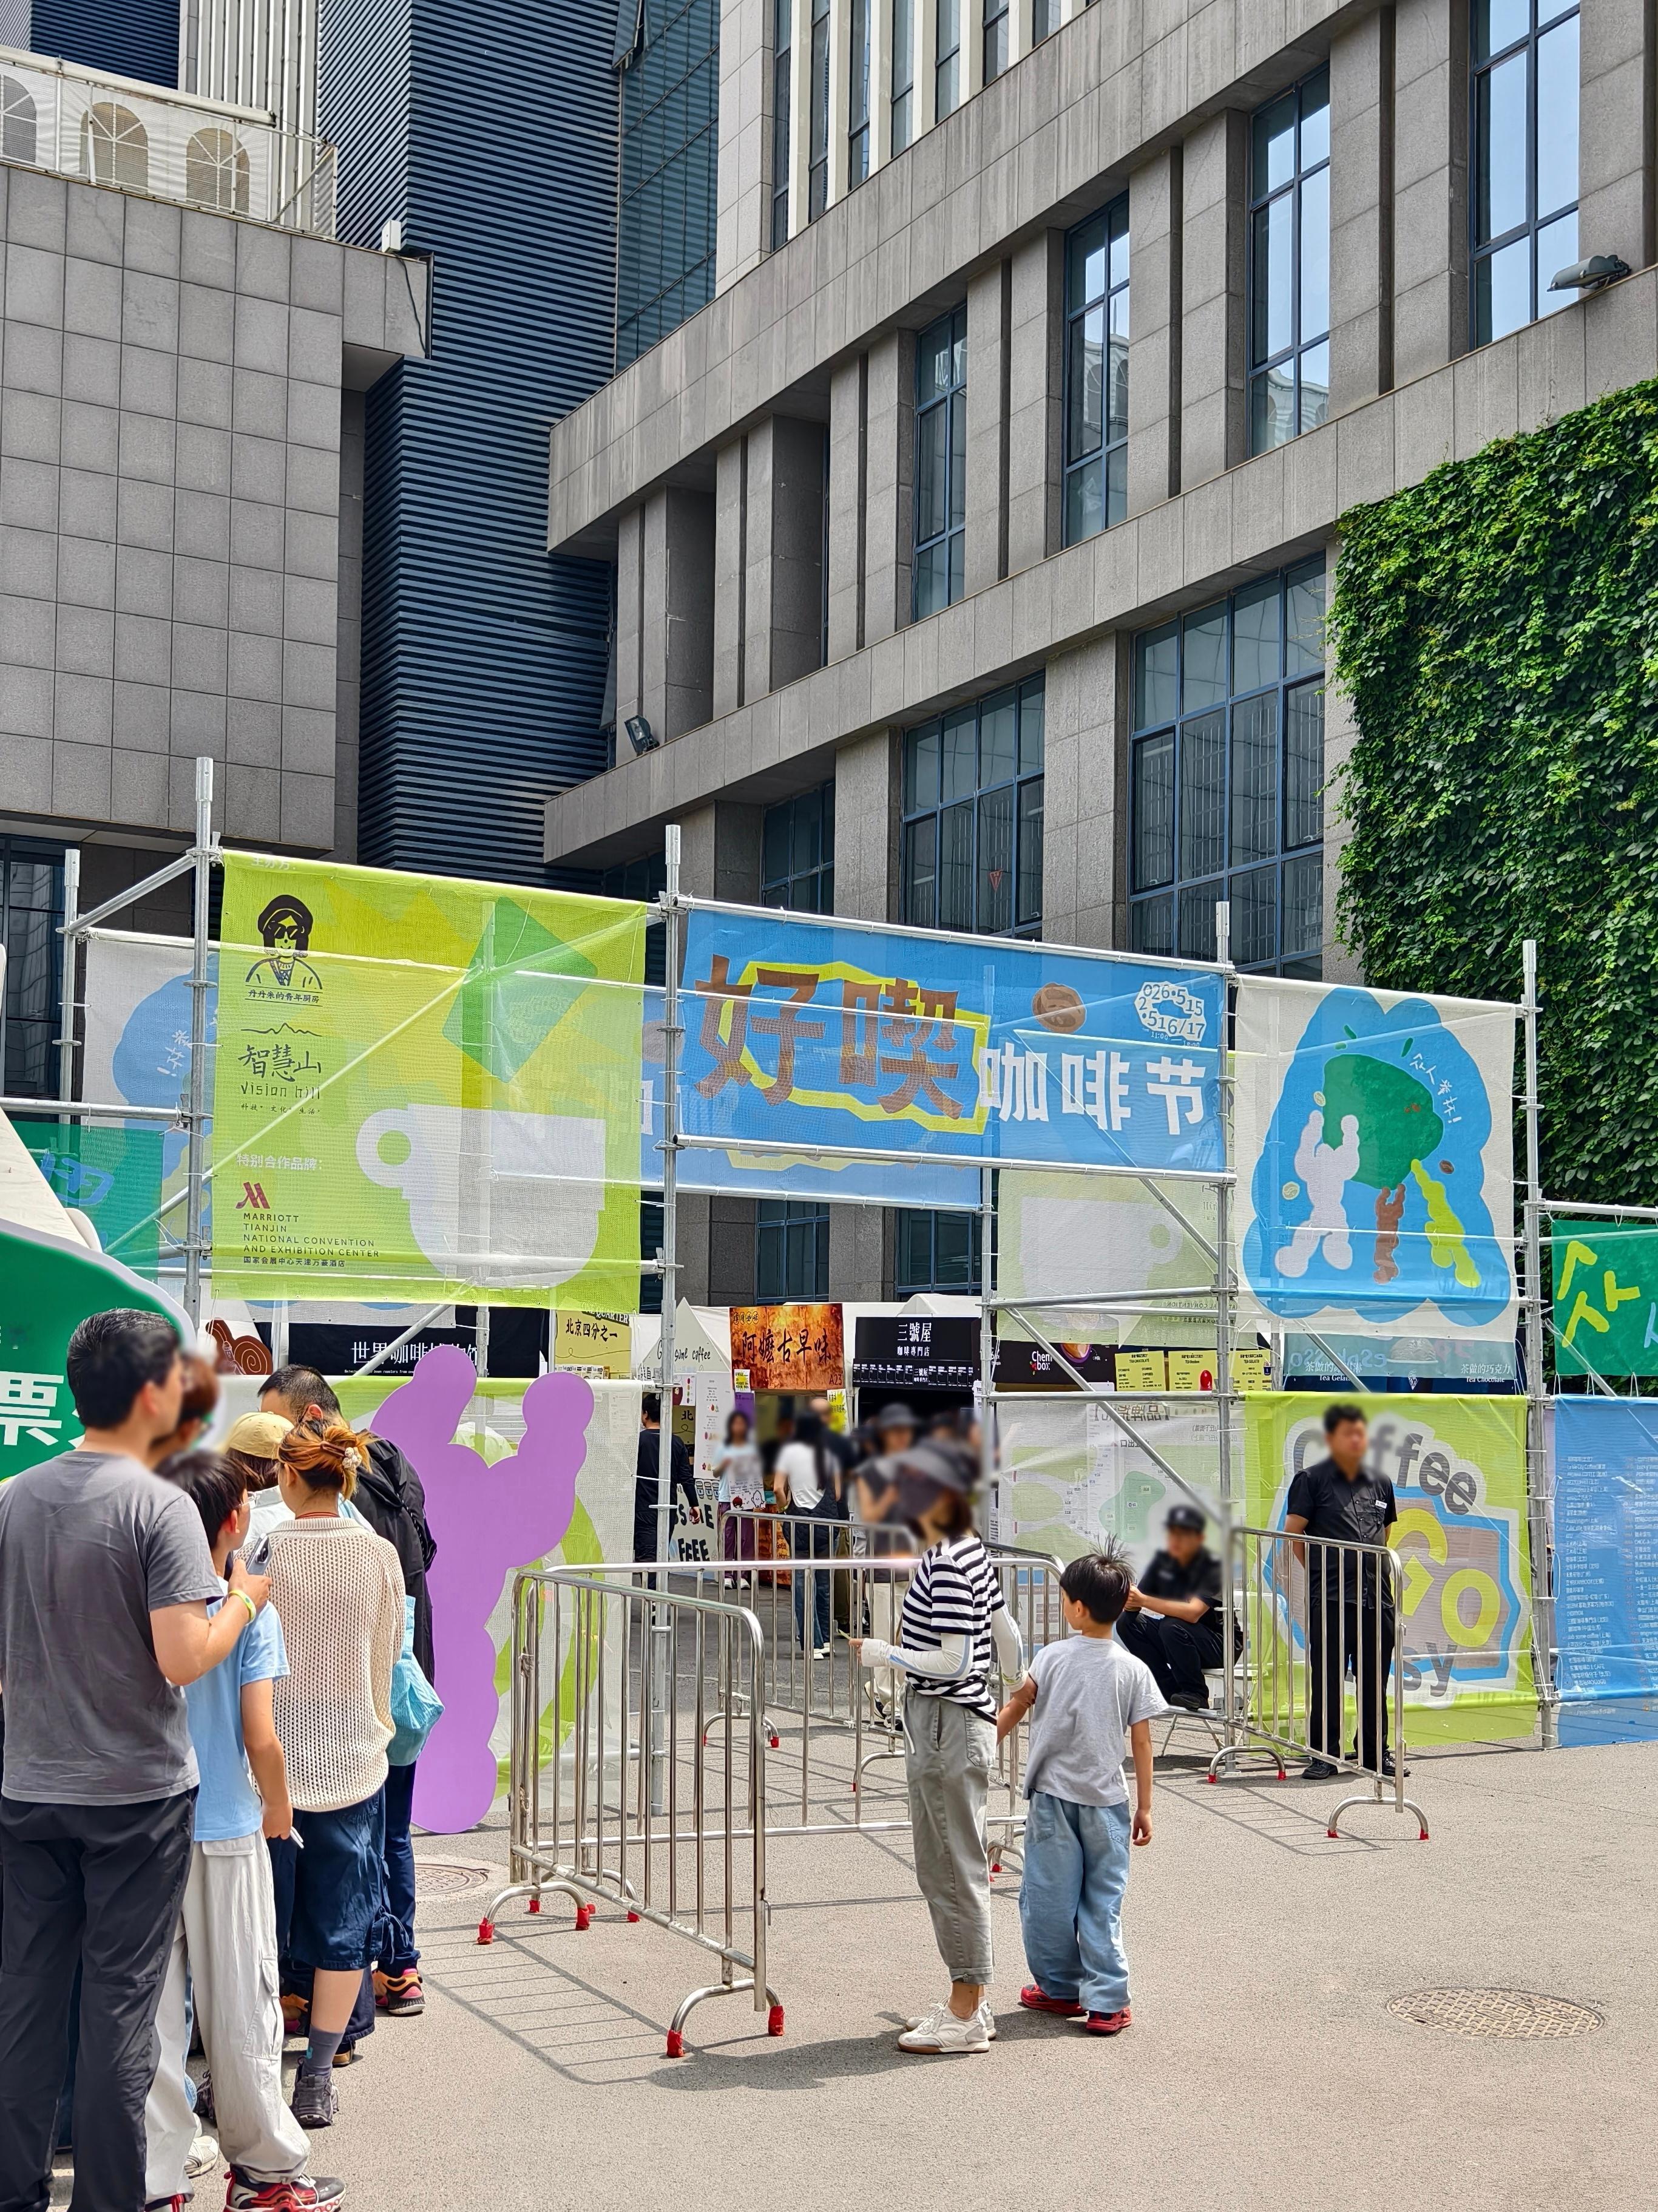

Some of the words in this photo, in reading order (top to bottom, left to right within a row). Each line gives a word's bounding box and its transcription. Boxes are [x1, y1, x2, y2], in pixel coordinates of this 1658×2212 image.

[238, 1044, 321, 1082] 智慧山
[980, 1042, 1205, 1135] 咖啡节
[244, 1213, 299, 1223] MARRIOTT
[243, 1223, 286, 1232] TIANJIN
[244, 1234, 299, 1243] NATIONAL
[304, 1237, 374, 1246] CONVENTION
[271, 1246, 334, 1255] EXHIBITION
[566, 1318, 618, 1342] 北京四分之一
[898, 1322, 932, 1342] 三號屋
[1037, 1362, 1051, 1371] box
[1461, 1363, 1510, 1374] 茶做的巧克力
[829, 1374, 842, 1385] A23
